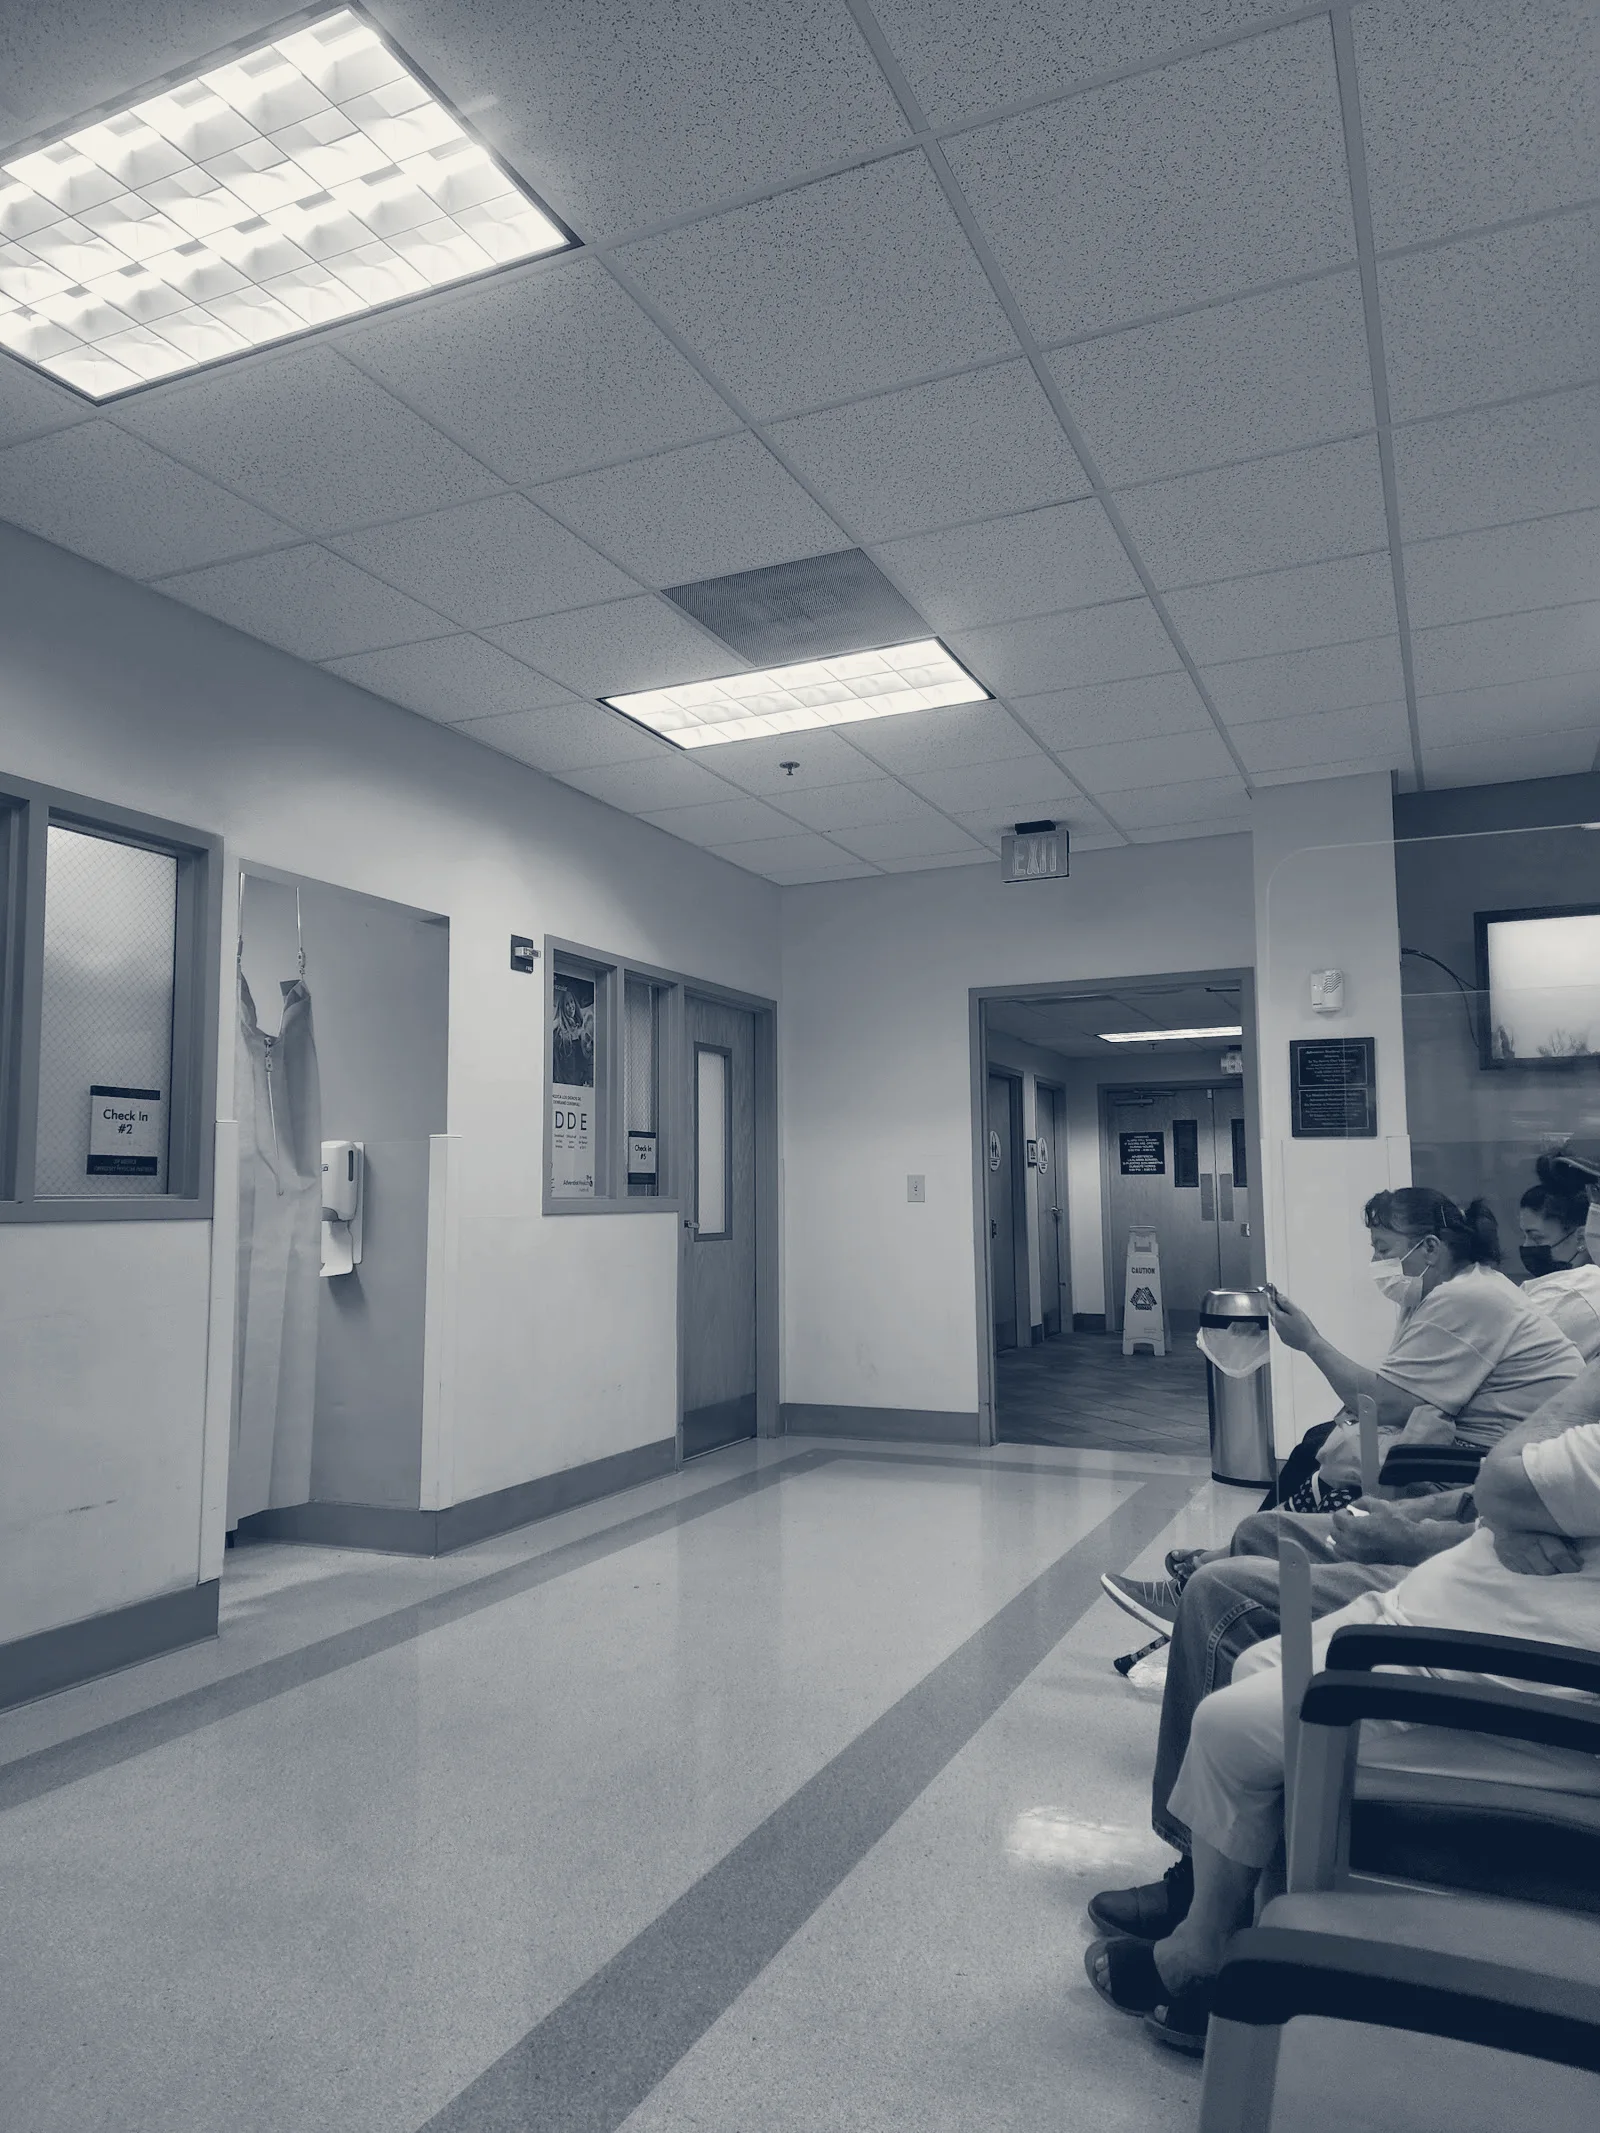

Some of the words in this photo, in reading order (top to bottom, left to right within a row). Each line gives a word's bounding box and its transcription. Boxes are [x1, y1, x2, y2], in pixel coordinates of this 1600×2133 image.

[1012, 838, 1057, 877] EXIT
[103, 1108, 136, 1121] Check
[139, 1111, 148, 1122] In
[118, 1124, 133, 1135] #2
[634, 1144, 647, 1152] Check
[1131, 1267, 1156, 1275] CAUTION
